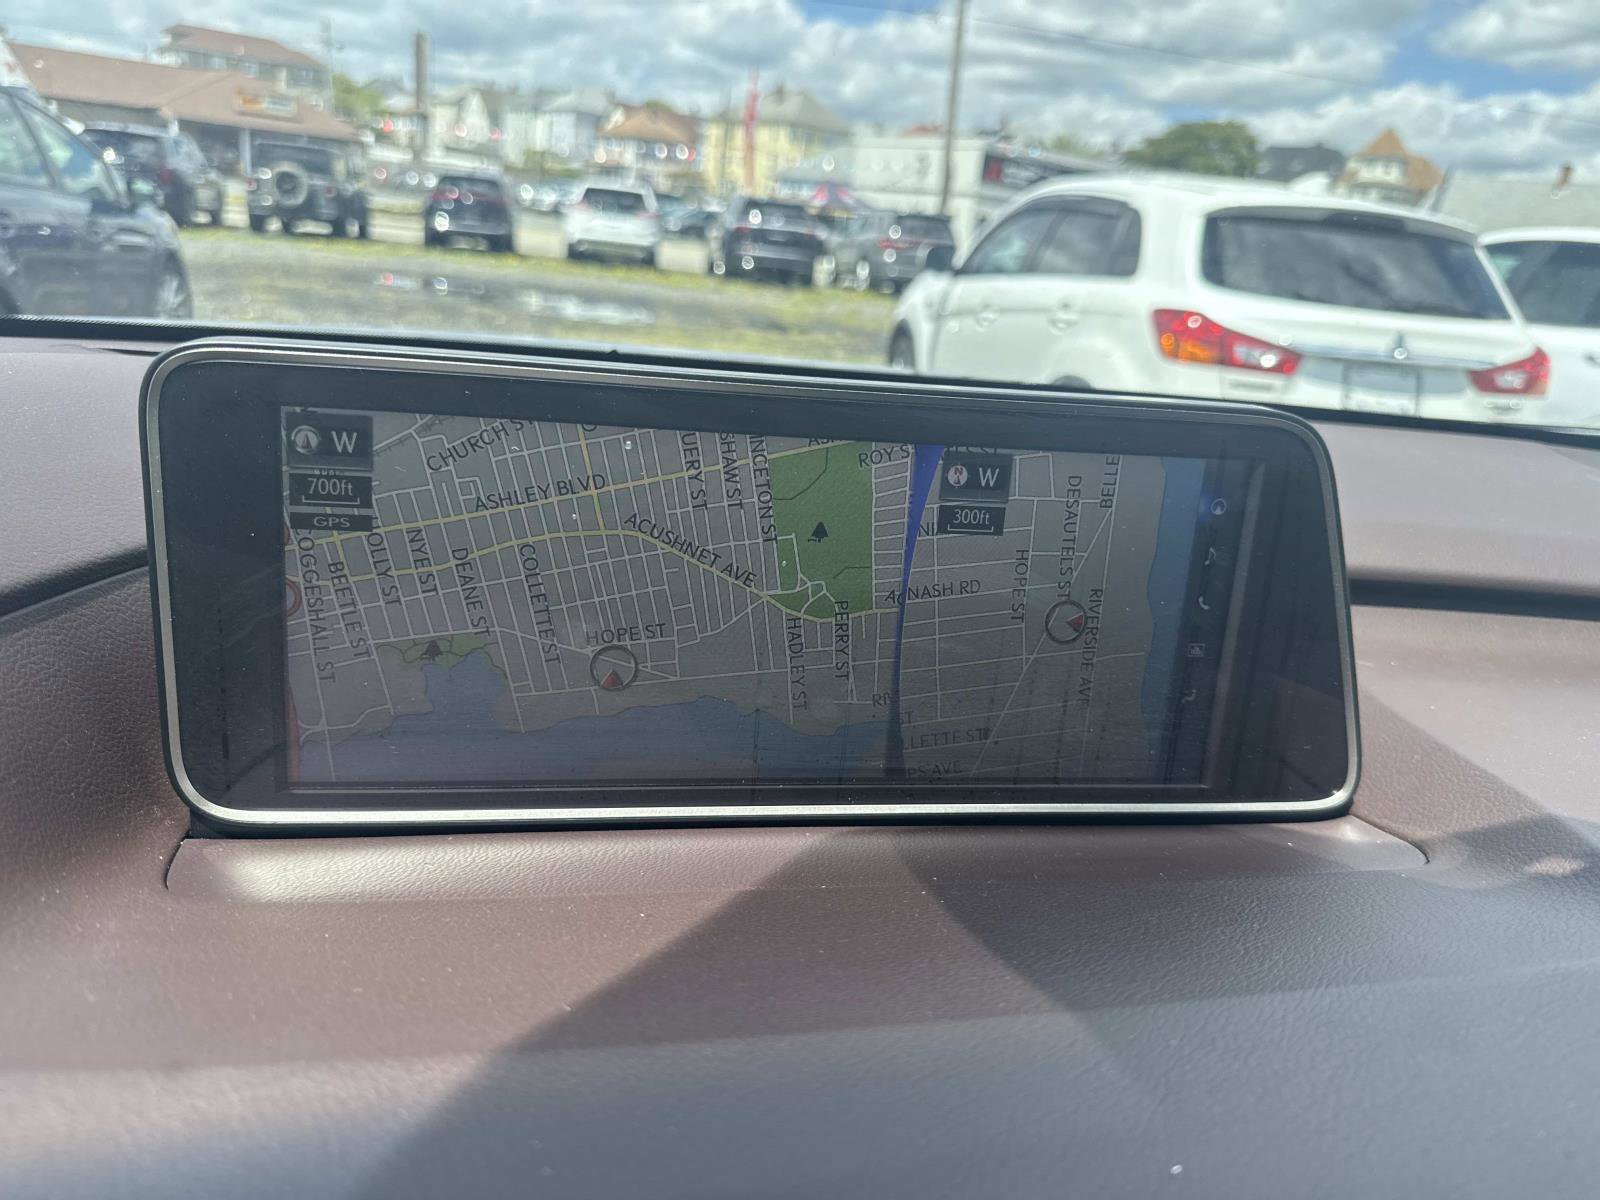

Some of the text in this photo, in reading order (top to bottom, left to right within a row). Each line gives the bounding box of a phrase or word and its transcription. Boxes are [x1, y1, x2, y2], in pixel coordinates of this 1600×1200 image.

[331, 431, 357, 453] W
[427, 423, 510, 471] CHURCH
[858, 444, 912, 469] ROY S
[307, 477, 353, 496] 700ft
[475, 474, 606, 512] ASHLEY BLVD
[682, 433, 708, 510] UERY ST
[978, 467, 1000, 487] W
[1100, 455, 1120, 509] BELLE
[727, 488, 743, 510] ST
[953, 508, 991, 525] 300ft
[313, 516, 351, 528] GPS
[761, 523, 778, 544] ST
[1057, 475, 1082, 600] DESAUTELS ST
[406, 528, 439, 595] NYE ST
[624, 513, 758, 588] ACUSHNET AVE
[382, 585, 401, 606] ST
[452, 548, 490, 637] DEANE ST
[519, 544, 561, 664] COLLETTE ST
[907, 579, 981, 600] NASH RD
[1010, 549, 1029, 623] HOPE ST
[328, 561, 370, 659] BEETLE ST
[1080, 588, 1104, 673] RIVERSIDE
[586, 623, 667, 646] HOPE ST
[834, 600, 850, 680] PERRY ST
[316, 661, 336, 683] ST
[786, 617, 807, 711] HADLEY ST
